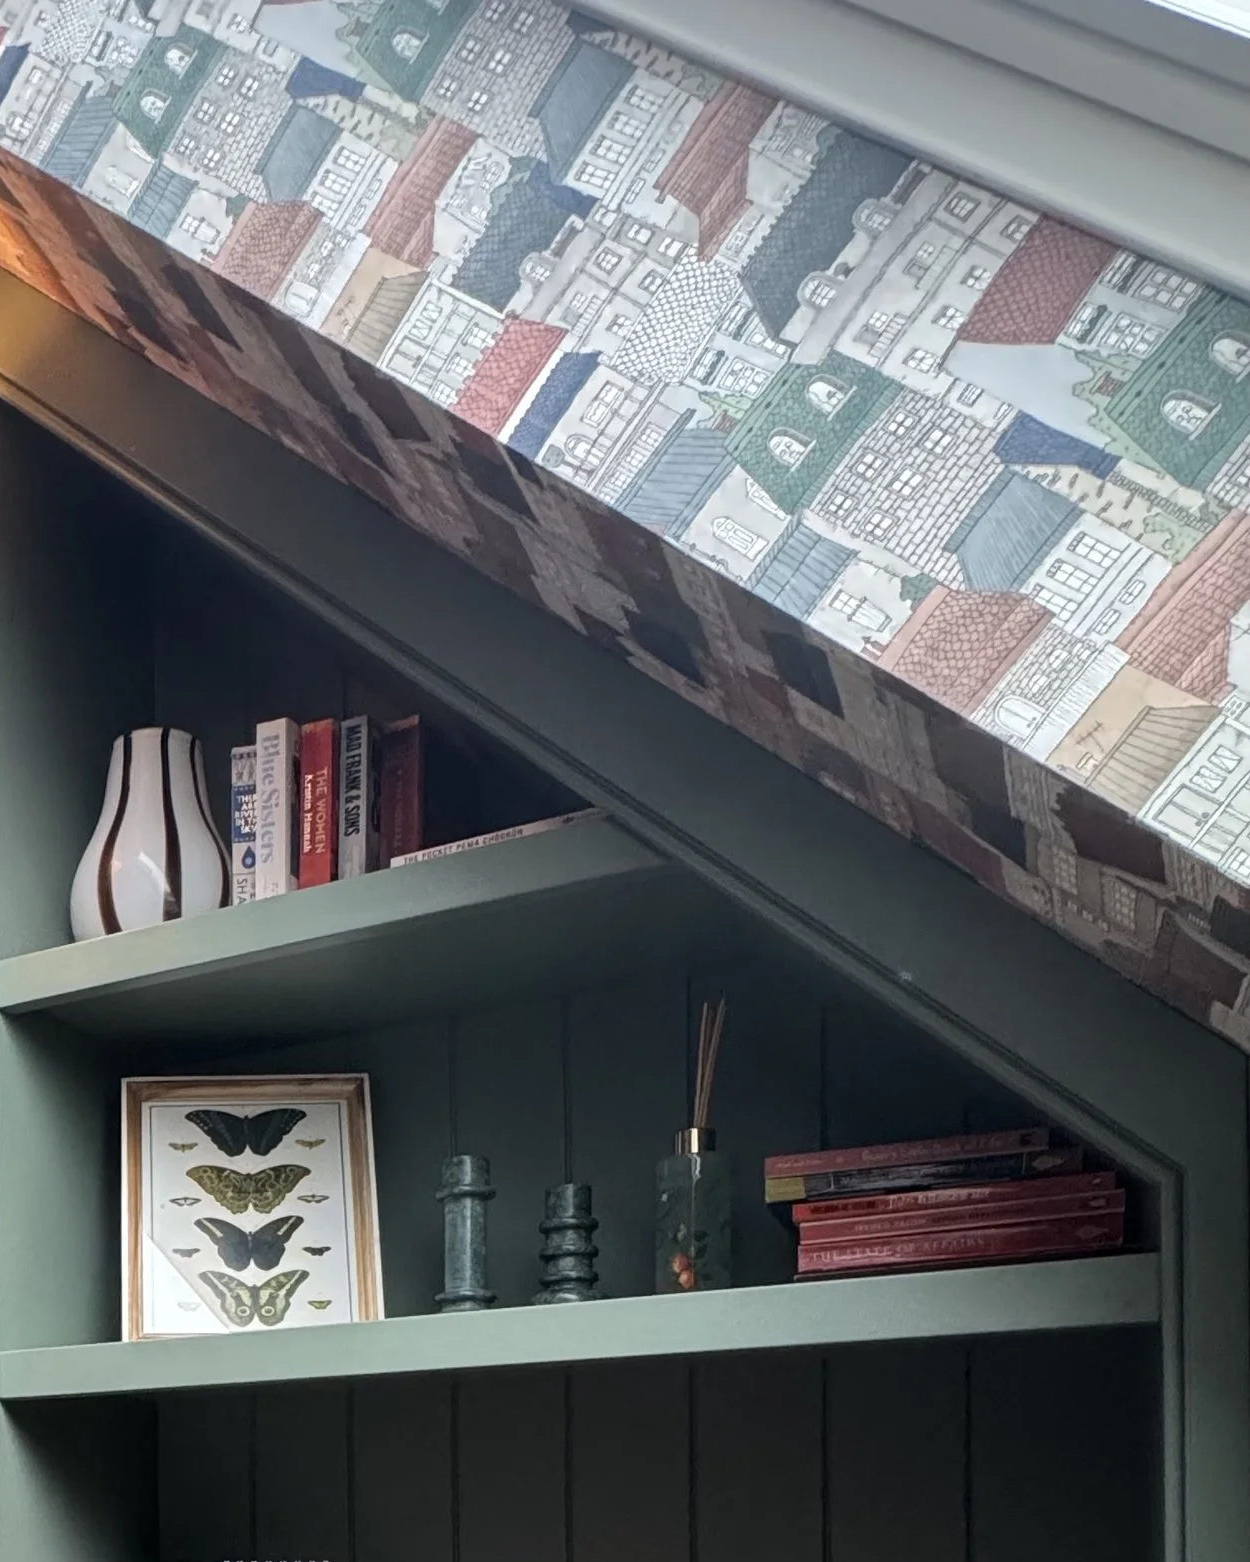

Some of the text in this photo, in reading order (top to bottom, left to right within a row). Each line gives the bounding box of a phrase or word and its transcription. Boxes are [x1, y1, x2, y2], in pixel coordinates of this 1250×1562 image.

[261, 732, 280, 786] Blue
[344, 724, 362, 838] MAD FRANK & SONS
[261, 788, 280, 864] Sisters
[314, 766, 328, 854] THE WOMEN
